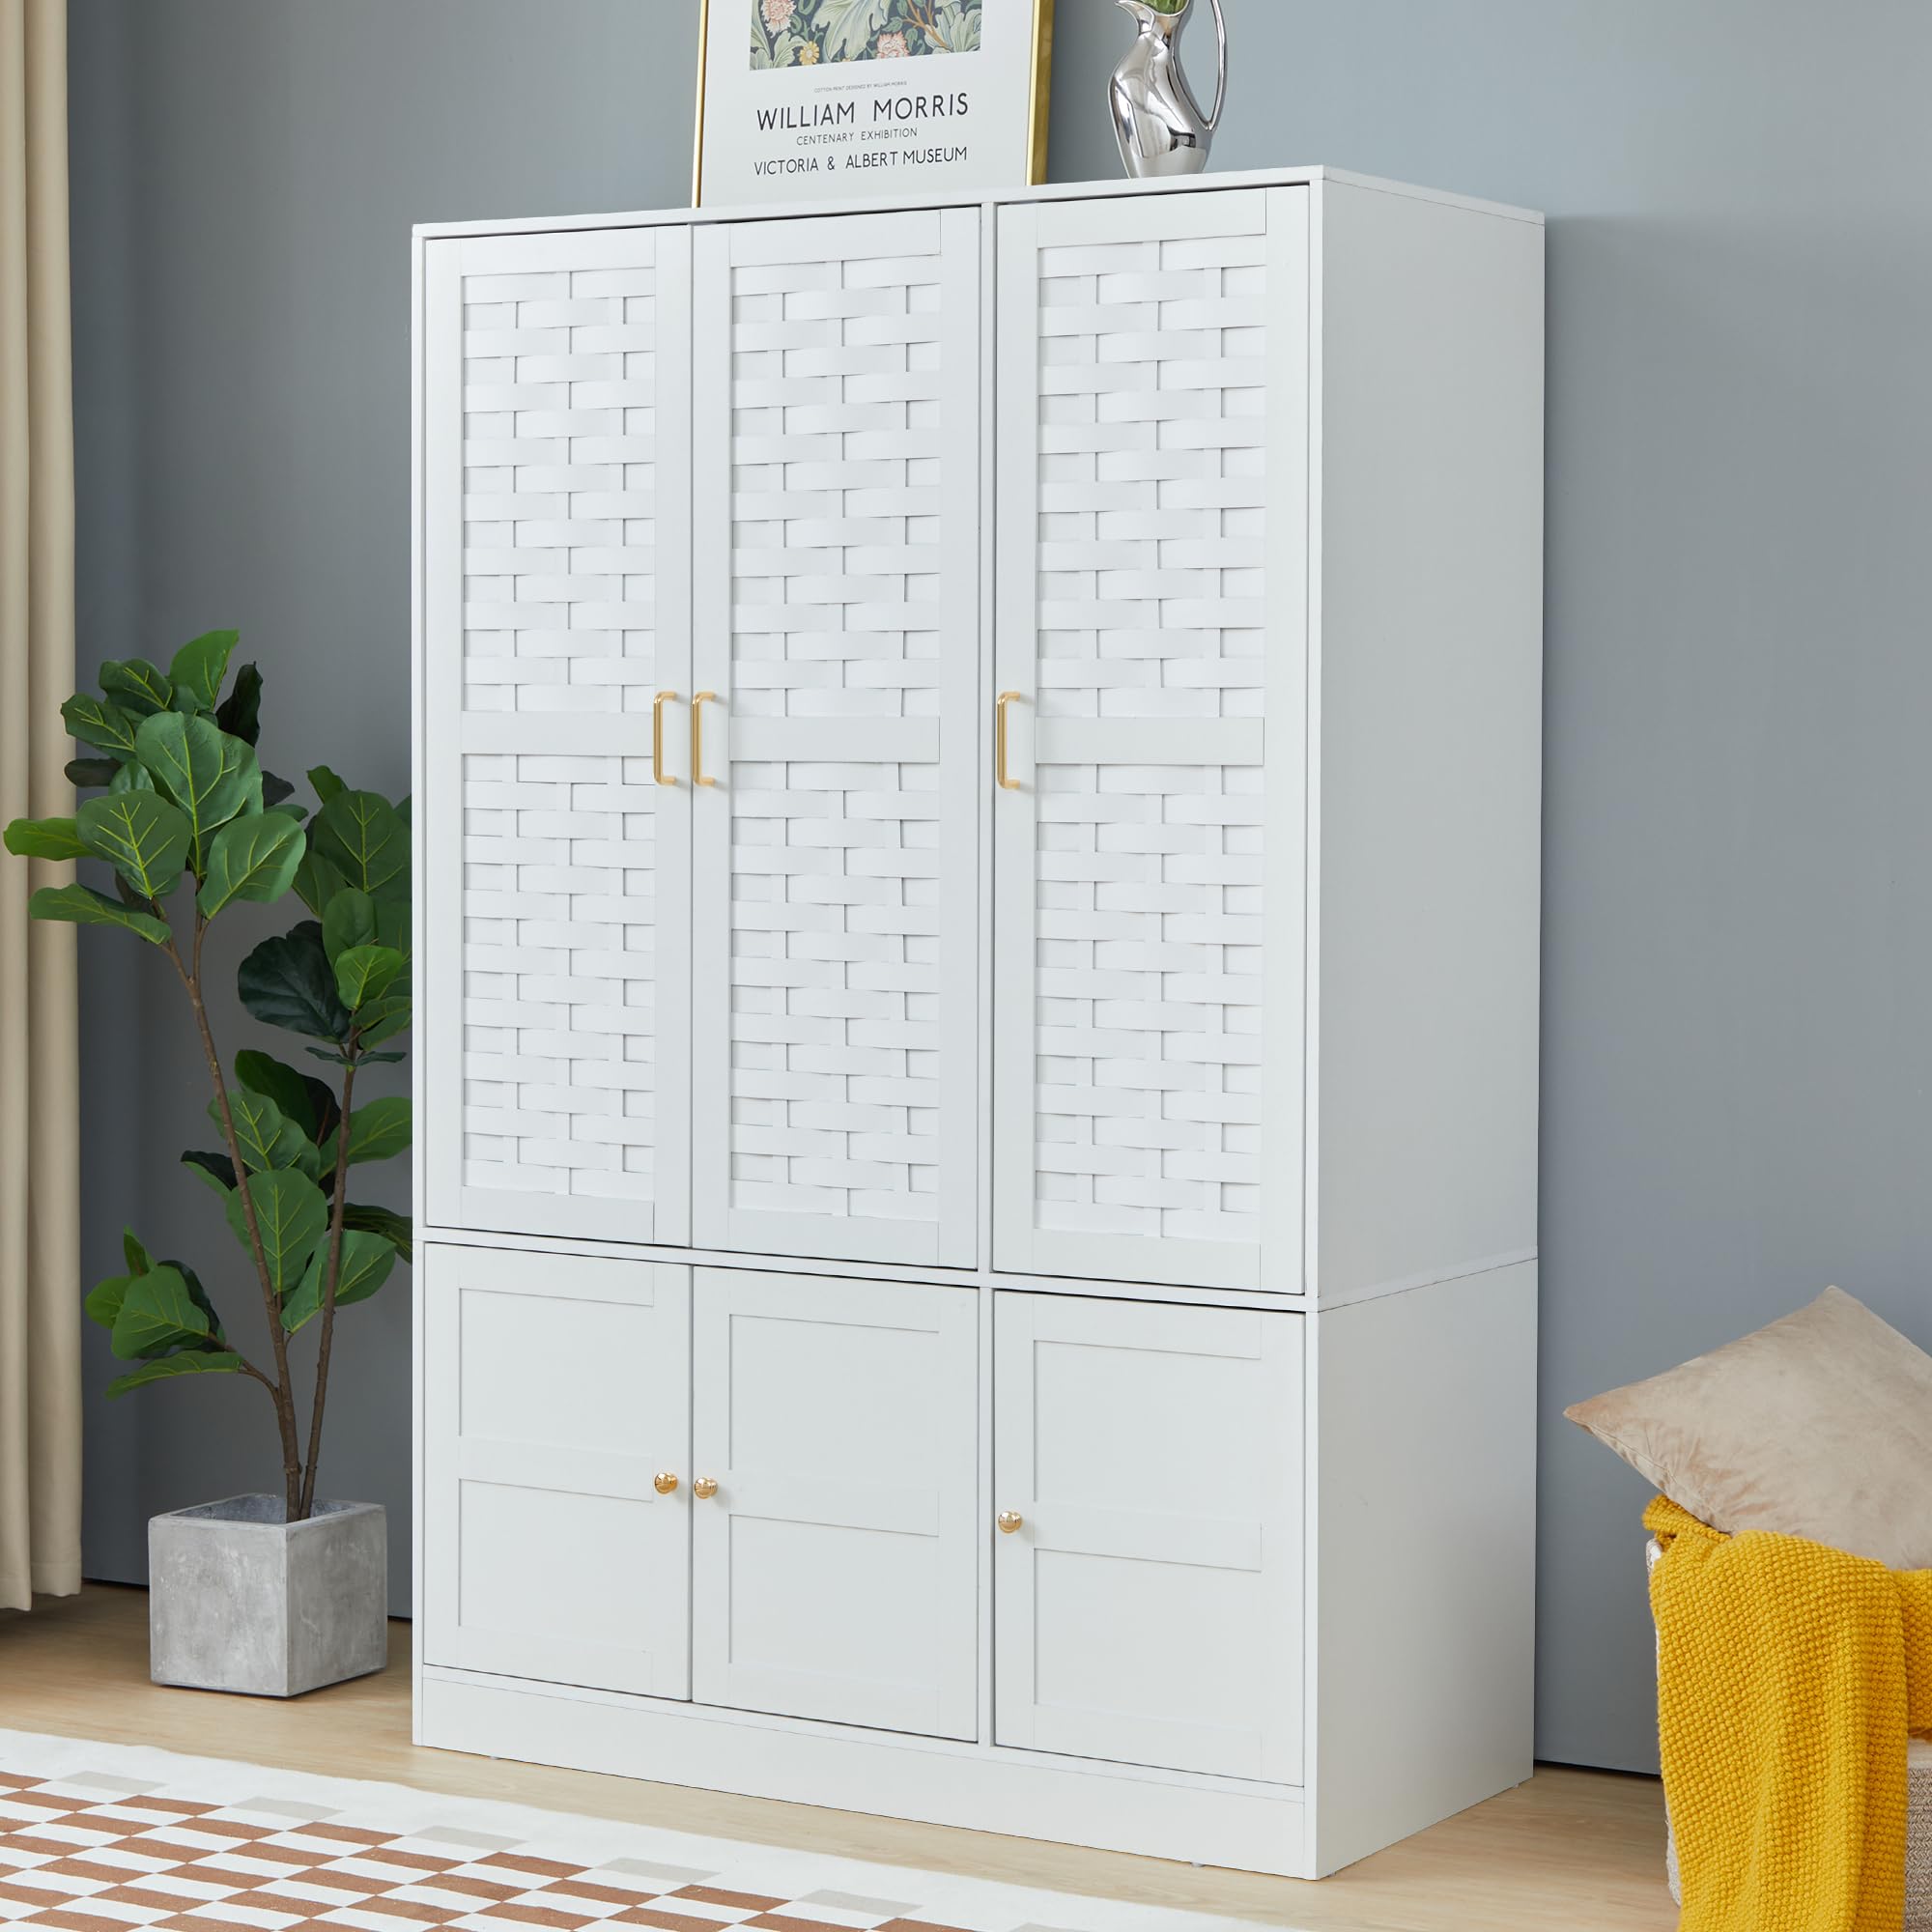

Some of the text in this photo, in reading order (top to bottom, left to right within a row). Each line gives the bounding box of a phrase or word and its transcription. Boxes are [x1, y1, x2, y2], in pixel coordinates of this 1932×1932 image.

[756, 92, 969, 131] WILLIAM MORRIS
[796, 127, 918, 146] CENTENARY EXHIBITION
[753, 146, 967, 176] VICTORIA & ALBERT MUSEUM
